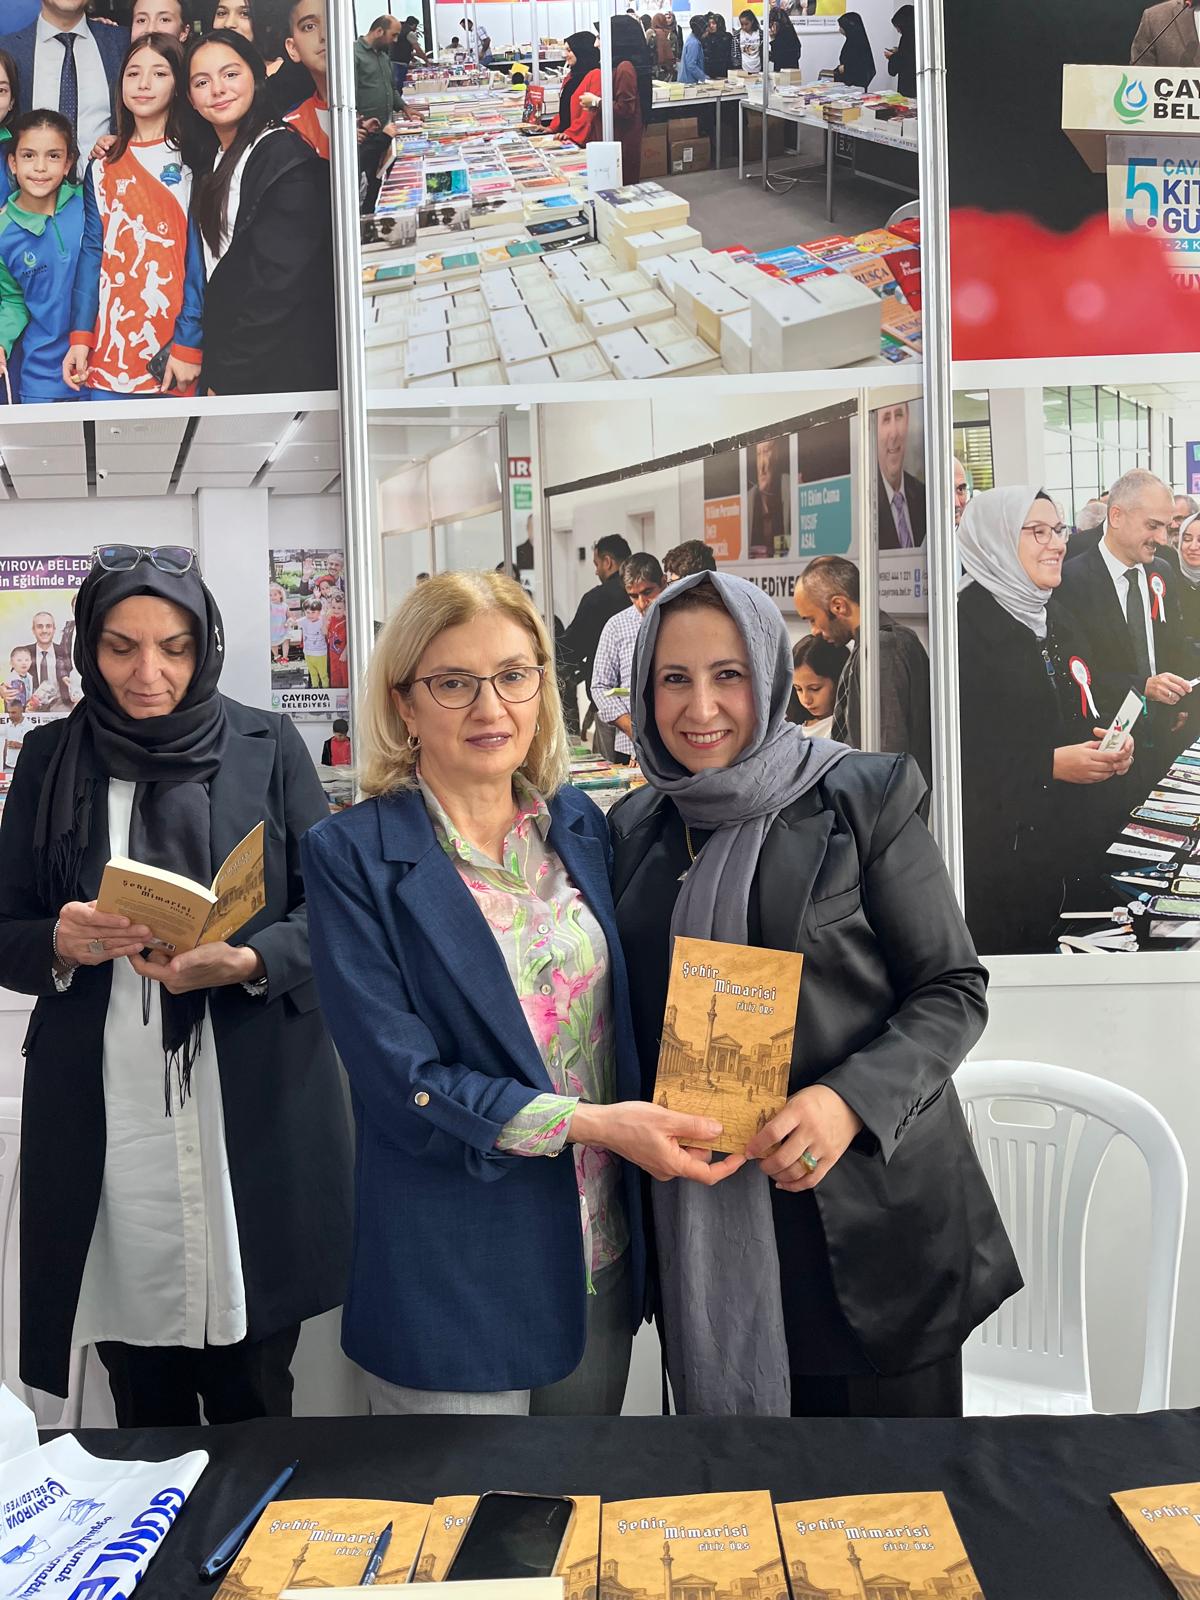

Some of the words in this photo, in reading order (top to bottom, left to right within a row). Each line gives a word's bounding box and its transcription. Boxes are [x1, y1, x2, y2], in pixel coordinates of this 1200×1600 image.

[1154, 103, 1200, 120] BEL
[13, 574, 64, 589] Eğitimde
[282, 693, 330, 703] ÇAYIROVA
[282, 701, 331, 709] BELEDİYESİ
[682, 961, 720, 979] Şehir
[713, 977, 776, 1001] Mimarisi
[1140, 1504, 1191, 1523] Şehir
[269, 1518, 320, 1534] Şehir
[617, 1517, 668, 1535] Şehir
[664, 1524, 749, 1540] Mimarisi
[795, 1517, 846, 1535] Şehir
[845, 1524, 931, 1541] Mimarisi
